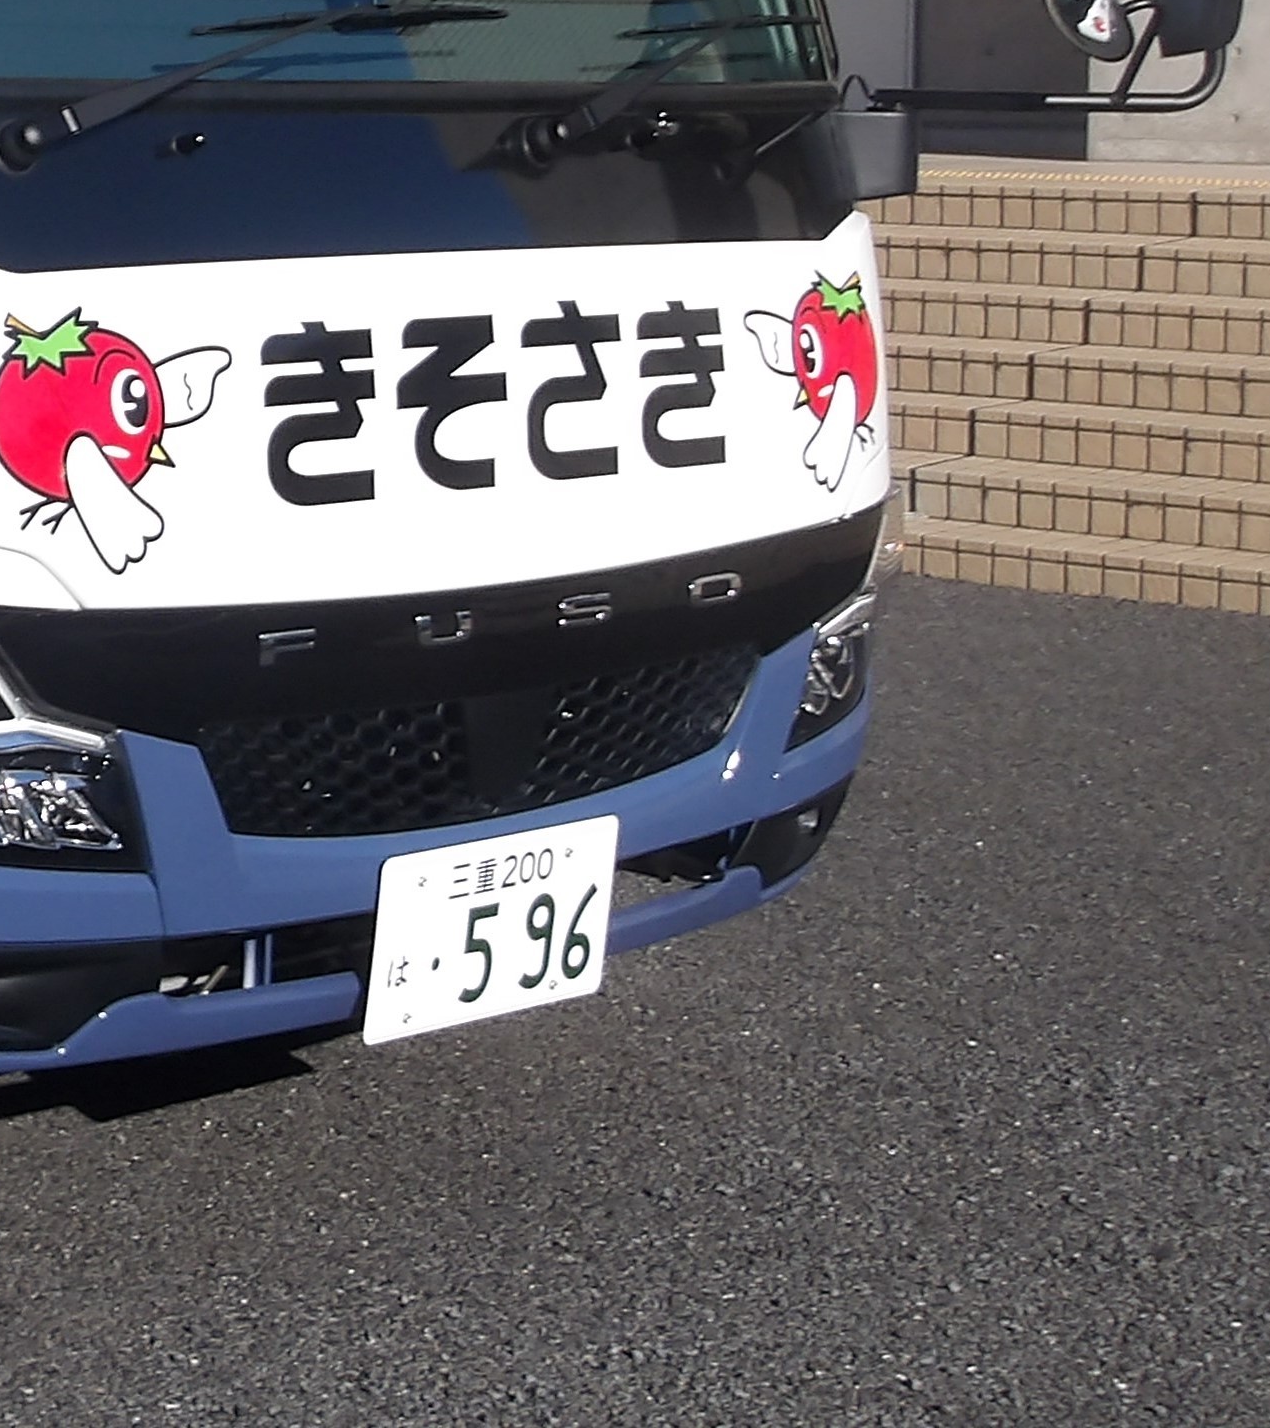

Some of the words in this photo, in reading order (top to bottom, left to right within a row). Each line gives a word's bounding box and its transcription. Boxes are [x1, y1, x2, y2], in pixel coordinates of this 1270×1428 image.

[260, 299, 726, 507] きそさき
[258, 571, 742, 667] FUSO
